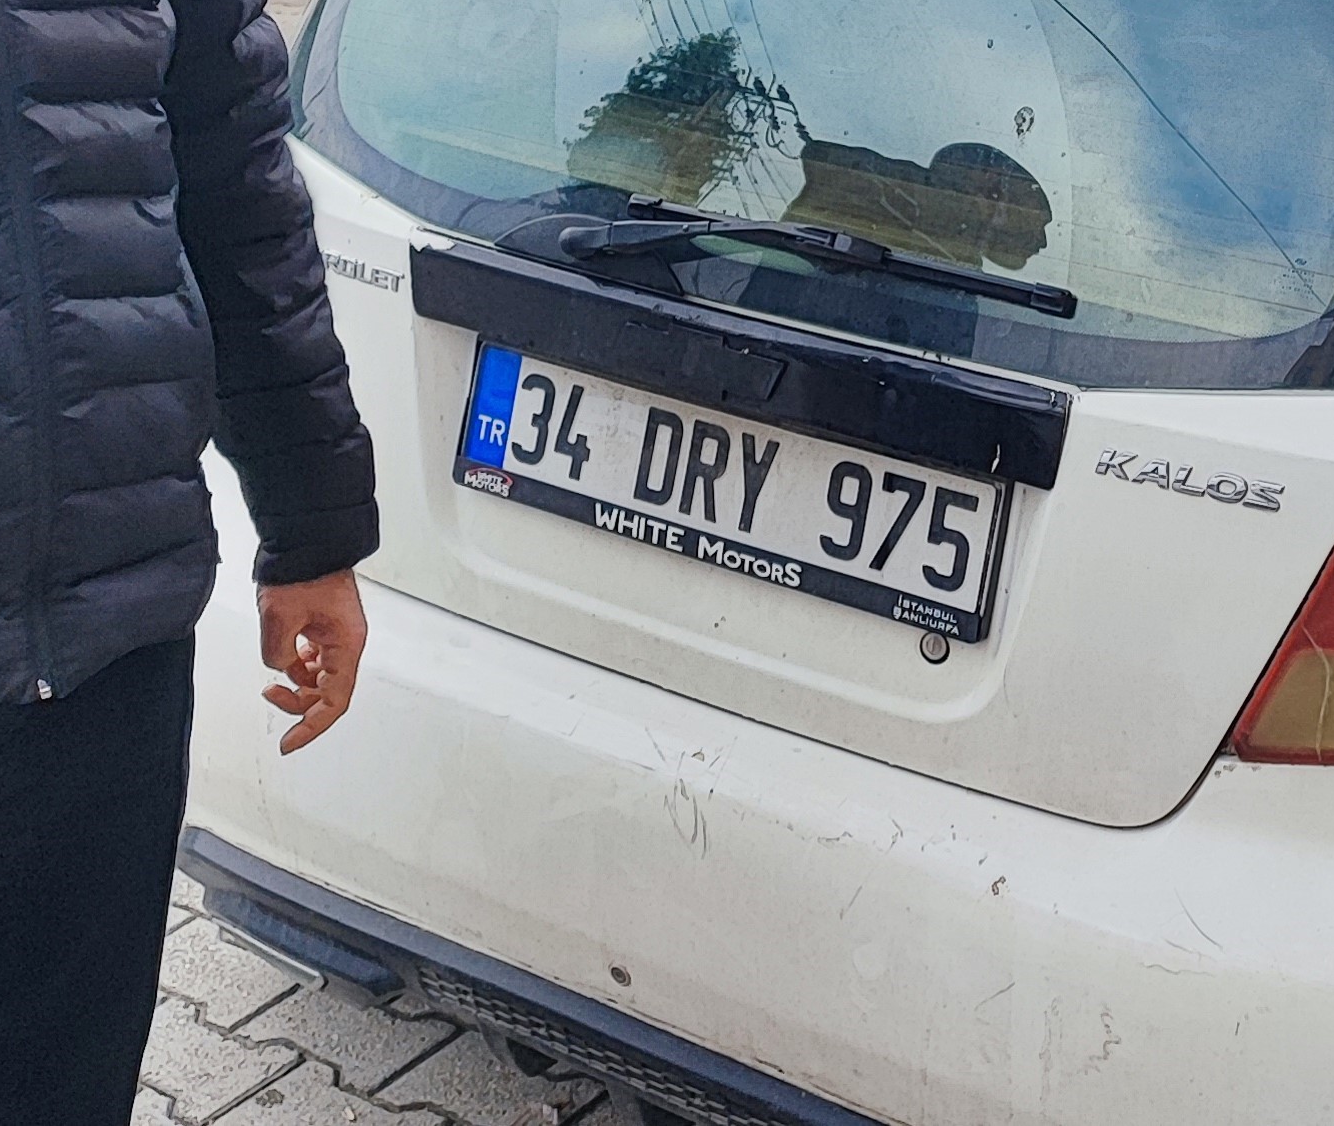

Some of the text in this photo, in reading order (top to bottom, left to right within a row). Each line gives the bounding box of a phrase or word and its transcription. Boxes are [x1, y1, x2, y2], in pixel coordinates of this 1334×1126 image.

[478, 414, 506, 446] TR
[511, 373, 979, 592] 34 DRY 975
[1094, 447, 1286, 513] KALOS
[595, 503, 685, 553] WHITE
